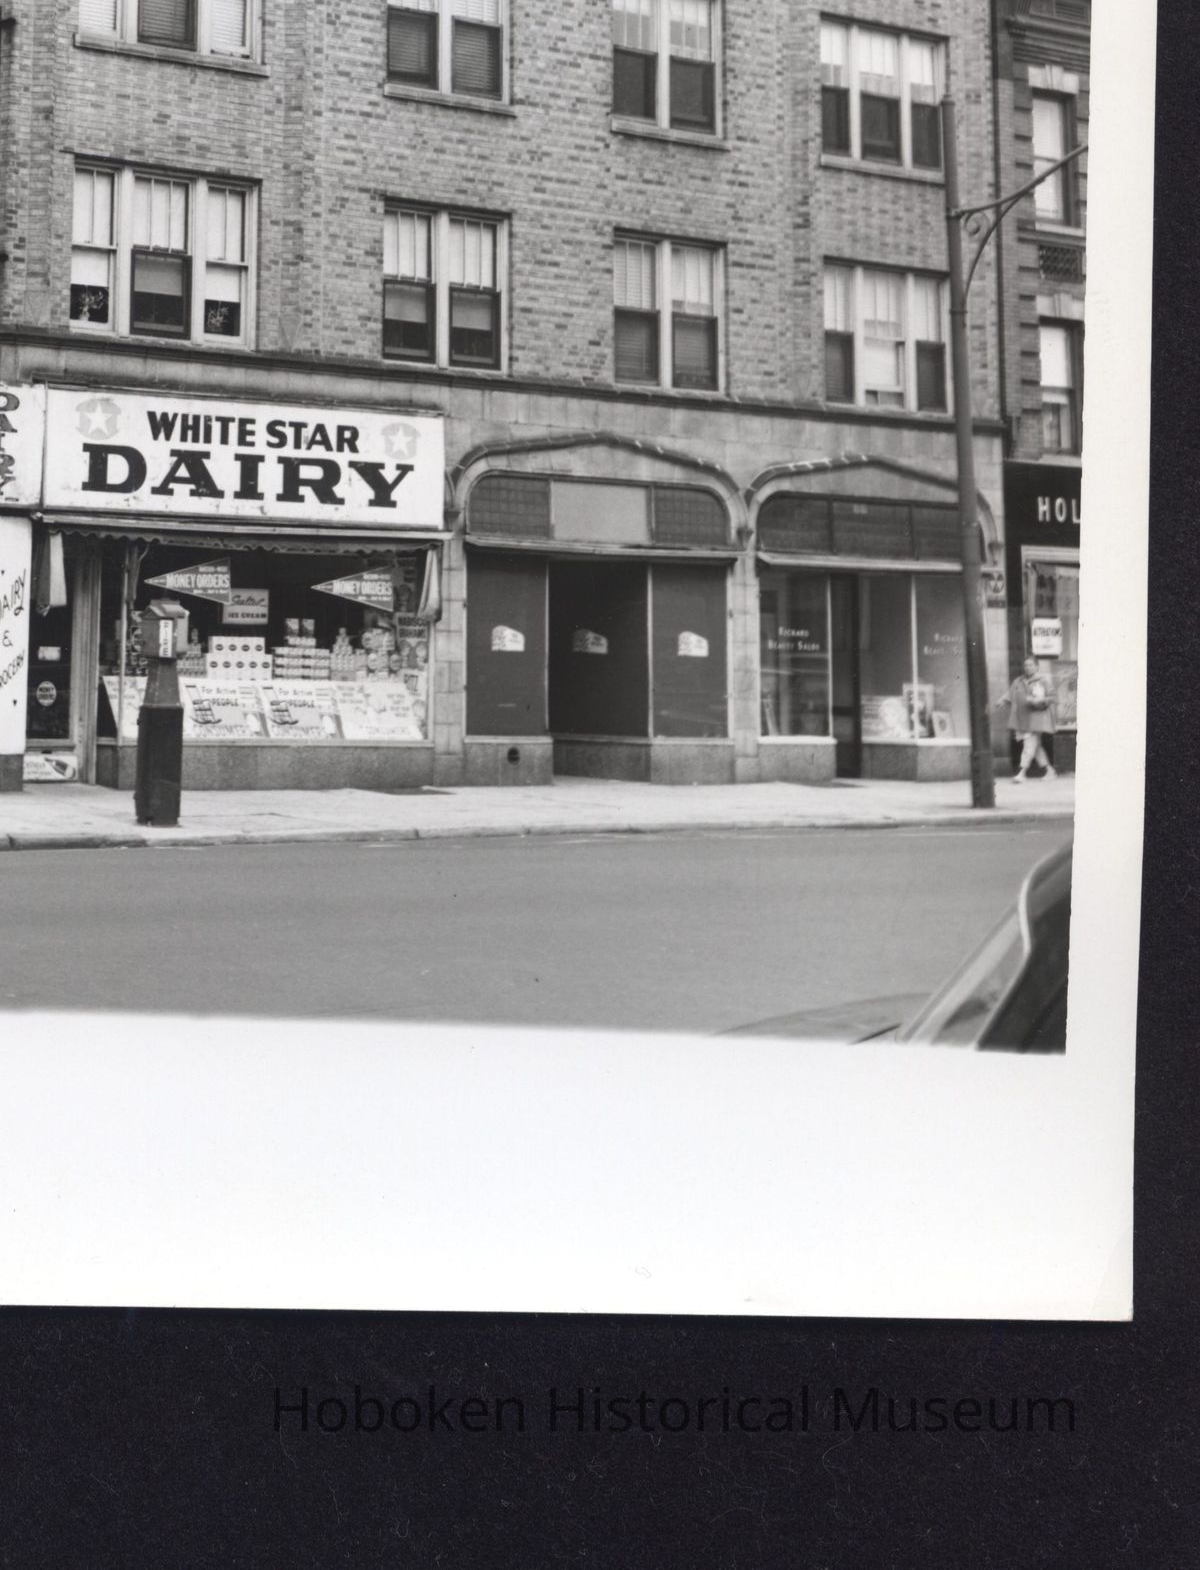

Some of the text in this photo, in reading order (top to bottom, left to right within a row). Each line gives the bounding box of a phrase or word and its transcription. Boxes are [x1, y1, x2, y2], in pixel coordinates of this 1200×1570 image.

[147, 411, 360, 454] WHITE STAR
[81, 442, 414, 509] DAIRY
[2, 630, 13, 648] &
